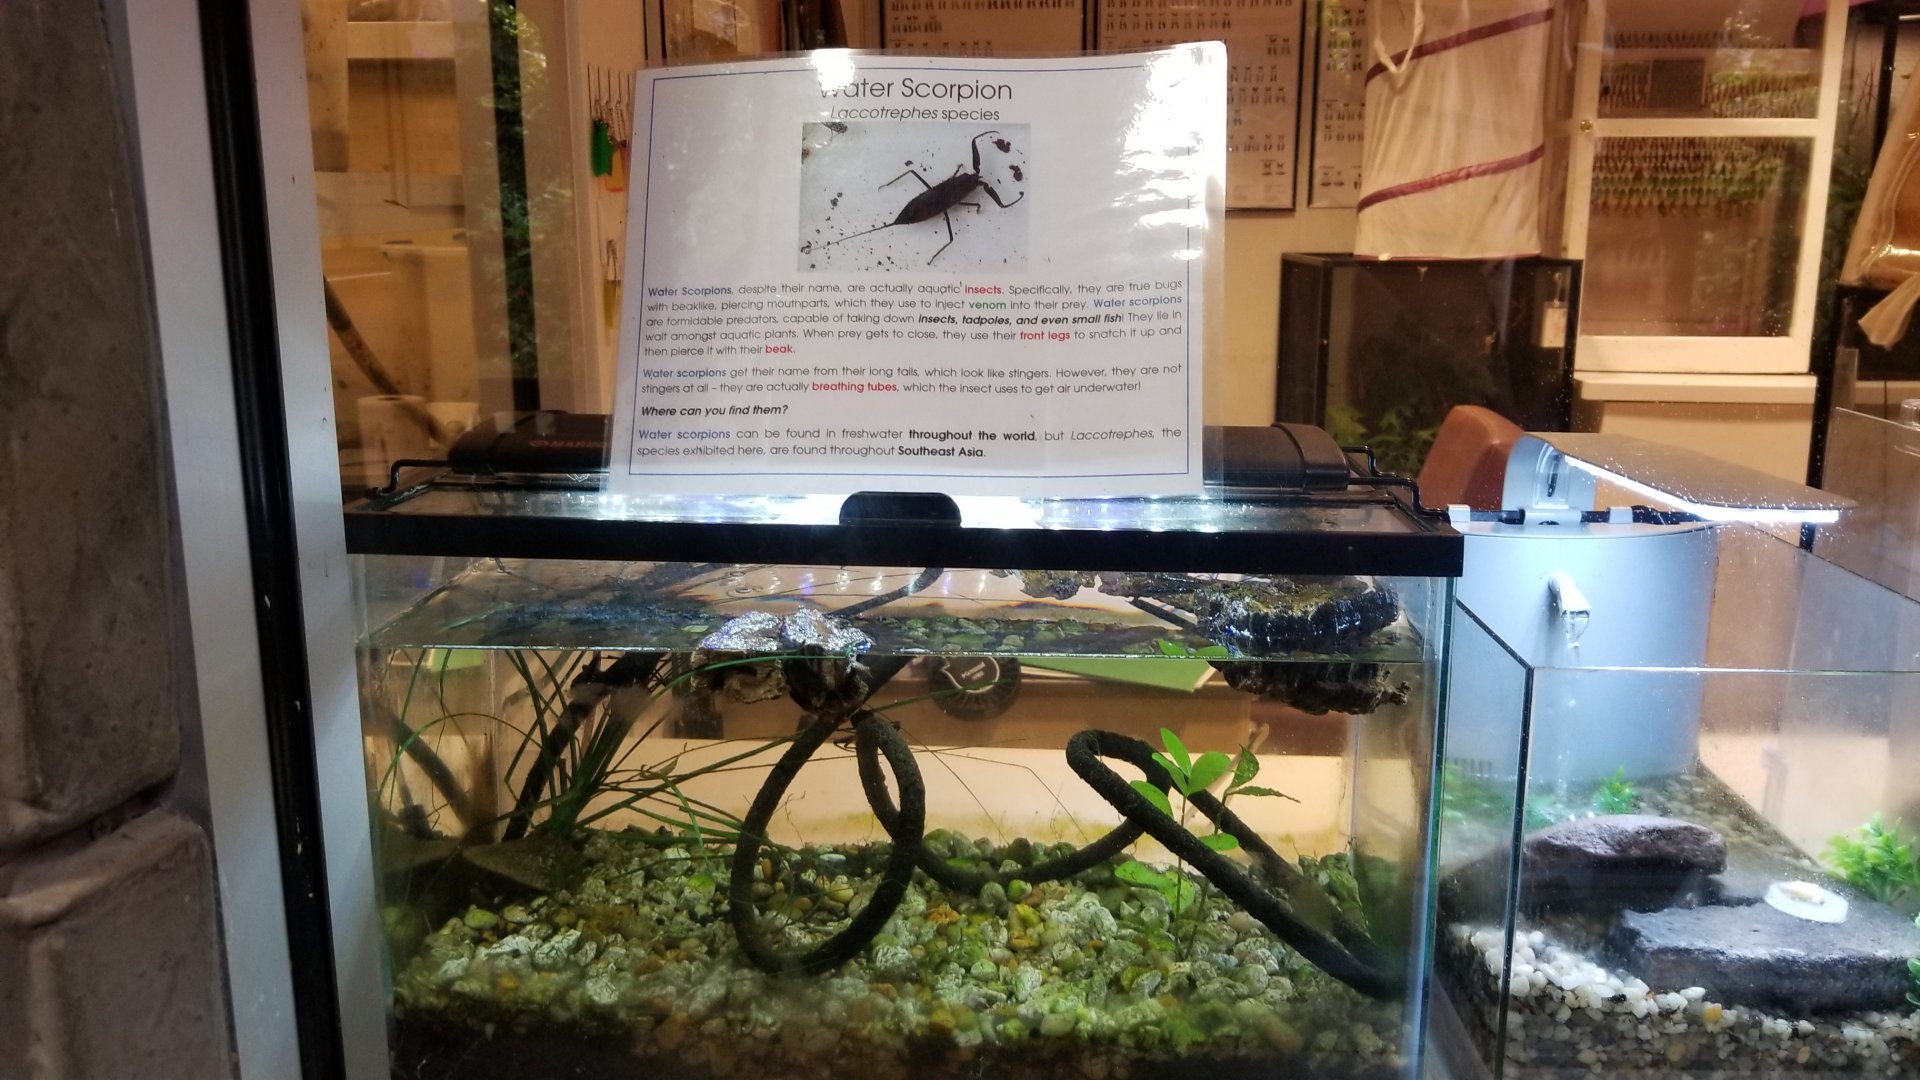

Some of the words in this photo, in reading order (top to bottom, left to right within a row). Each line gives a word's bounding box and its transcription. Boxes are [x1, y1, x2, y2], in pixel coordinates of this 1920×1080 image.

[817, 77, 895, 99] ater
[901, 77, 1013, 104] Scorpion
[830, 106, 938, 121] Laccotrephes
[941, 107, 1000, 123] species
[647, 287, 678, 297] Water
[681, 286, 734, 297] Scorpions,
[738, 284, 777, 295] despite
[781, 283, 805, 293] their
[808, 284, 842, 293] name,
[847, 284, 866, 293] are
[869, 283, 914, 295] actually
[964, 284, 1004, 295] insects.
[1008, 284, 1072, 296] Specifically,
[1077, 283, 1102, 295] they
[1105, 284, 1125, 293] are
[1129, 282, 1151, 291] true
[1155, 280, 1183, 291] bugs
[647, 302, 668, 312] with
[671, 301, 717, 311] beaklike,
[721, 300, 764, 312] piercing
[767, 298, 830, 309] mouthparts,
[834, 298, 867, 308] which
[870, 298, 895, 310] they
[898, 300, 917, 309] use
[920, 299, 932, 309] to
[935, 299, 965, 311] inject
[968, 301, 1007, 310] venom
[1010, 300, 1031, 310] into
[1034, 300, 1059, 310] their
[1061, 301, 1089, 311] prey.
[1093, 298, 1126, 308] Water
[1129, 296, 1182, 307] scorpions
[645, 319, 664, 327] are
[667, 316, 724, 326] formidable
[726, 315, 779, 326] predators,
[782, 313, 829, 324] capable
[832, 313, 844, 323] of
[846, 313, 880, 325] taking
[883, 313, 915, 323] down
[918, 314, 958, 325] insects,
[961, 315, 1012, 326] tadpoles,
[1015, 314, 1039, 325] and
[1040, 316, 1069, 325] even
[1071, 314, 1102, 325] small
[1127, 312, 1154, 323] They
[1156, 311, 1169, 320] lie
[1172, 309, 1182, 319] in
[645, 332, 667, 342] wait
[670, 331, 717, 343] amongst
[719, 330, 761, 341] aquatic
[764, 329, 799, 341] plants.
[802, 328, 834, 338] When
[837, 330, 863, 340] prey
[865, 328, 889, 341] gets
[892, 328, 904, 339] to
[907, 329, 938, 340] close,
[942, 329, 967, 342] they
[970, 332, 989, 340] use
[992, 330, 1017, 341] their
[1020, 330, 1045, 341] front
[1048, 330, 1071, 342] legs
[1074, 329, 1086, 340] to
[1089, 328, 1127, 339] snatch
[1130, 327, 1137, 337] it
[1140, 328, 1155, 339] up
[1158, 325, 1182, 336] and
[644, 347, 668, 356] then
[670, 347, 705, 358] pierce
[707, 345, 713, 355] it
[715, 345, 737, 355] with
[740, 345, 763, 354] their
[765, 344, 796, 354] beak.
[643, 369, 674, 378] Water
[676, 368, 727, 379] scorpions
[729, 367, 748, 379] get
[752, 367, 775, 377] their
[777, 368, 810, 376] name
[813, 366, 838, 376] from
[842, 366, 866, 376] their
[869, 366, 894, 379] long
[897, 366, 920, 377] tails,
[924, 367, 957, 377] which
[960, 368, 984, 378] look
[987, 368, 1005, 378] like
[1008, 368, 1052, 381] stingers.
[1055, 368, 1107, 378] However,
[1111, 366, 1137, 378] they
[1140, 366, 1159, 375] are
[1163, 363, 1182, 374] not
[641, 384, 681, 396] stingers
[682, 383, 694, 393] at
[696, 383, 709, 393] all
[719, 383, 744, 394] they
[745, 383, 764, 392] are
[766, 381, 810, 393] actually
[811, 381, 865, 394] breathing
[867, 381, 900, 392] tubes,
[902, 382, 936, 393] which
[938, 382, 957, 393] the
[959, 383, 992, 394] insect
[994, 385, 1018, 394] uses
[1020, 384, 1033, 394] to
[1034, 384, 1054, 396] get
[1056, 383, 1071, 394] air
[1073, 381, 1141, 393] underwater!
[641, 406, 677, 417] Where
[679, 407, 702, 416] can
[704, 407, 727, 418] you
[728, 405, 751, 416] find
[752, 404, 789, 415] them?
[638, 429, 672, 440] Water
[677, 429, 731, 441] scorpions
[736, 430, 759, 439] can
[764, 428, 781, 439] be
[786, 428, 821, 439] found
[826, 428, 836, 438] in
[841, 428, 903, 439] freshwater
[908, 429, 973, 442] throughout
[978, 430, 997, 441] the
[1002, 430, 1038, 442] world,
[1044, 430, 1065, 441] but
[1070, 429, 1155, 441] Laccotrephes,
[1161, 427, 1182, 438] the
[636, 446, 680, 458] species
[682, 445, 735, 456] exhibited
[737, 445, 766, 455] here,
[769, 446, 790, 455] are
[792, 444, 827, 455] found
[829, 445, 896, 458] throughout
[897, 445, 956, 457] Southeast
[958, 446, 986, 458] Asia.
